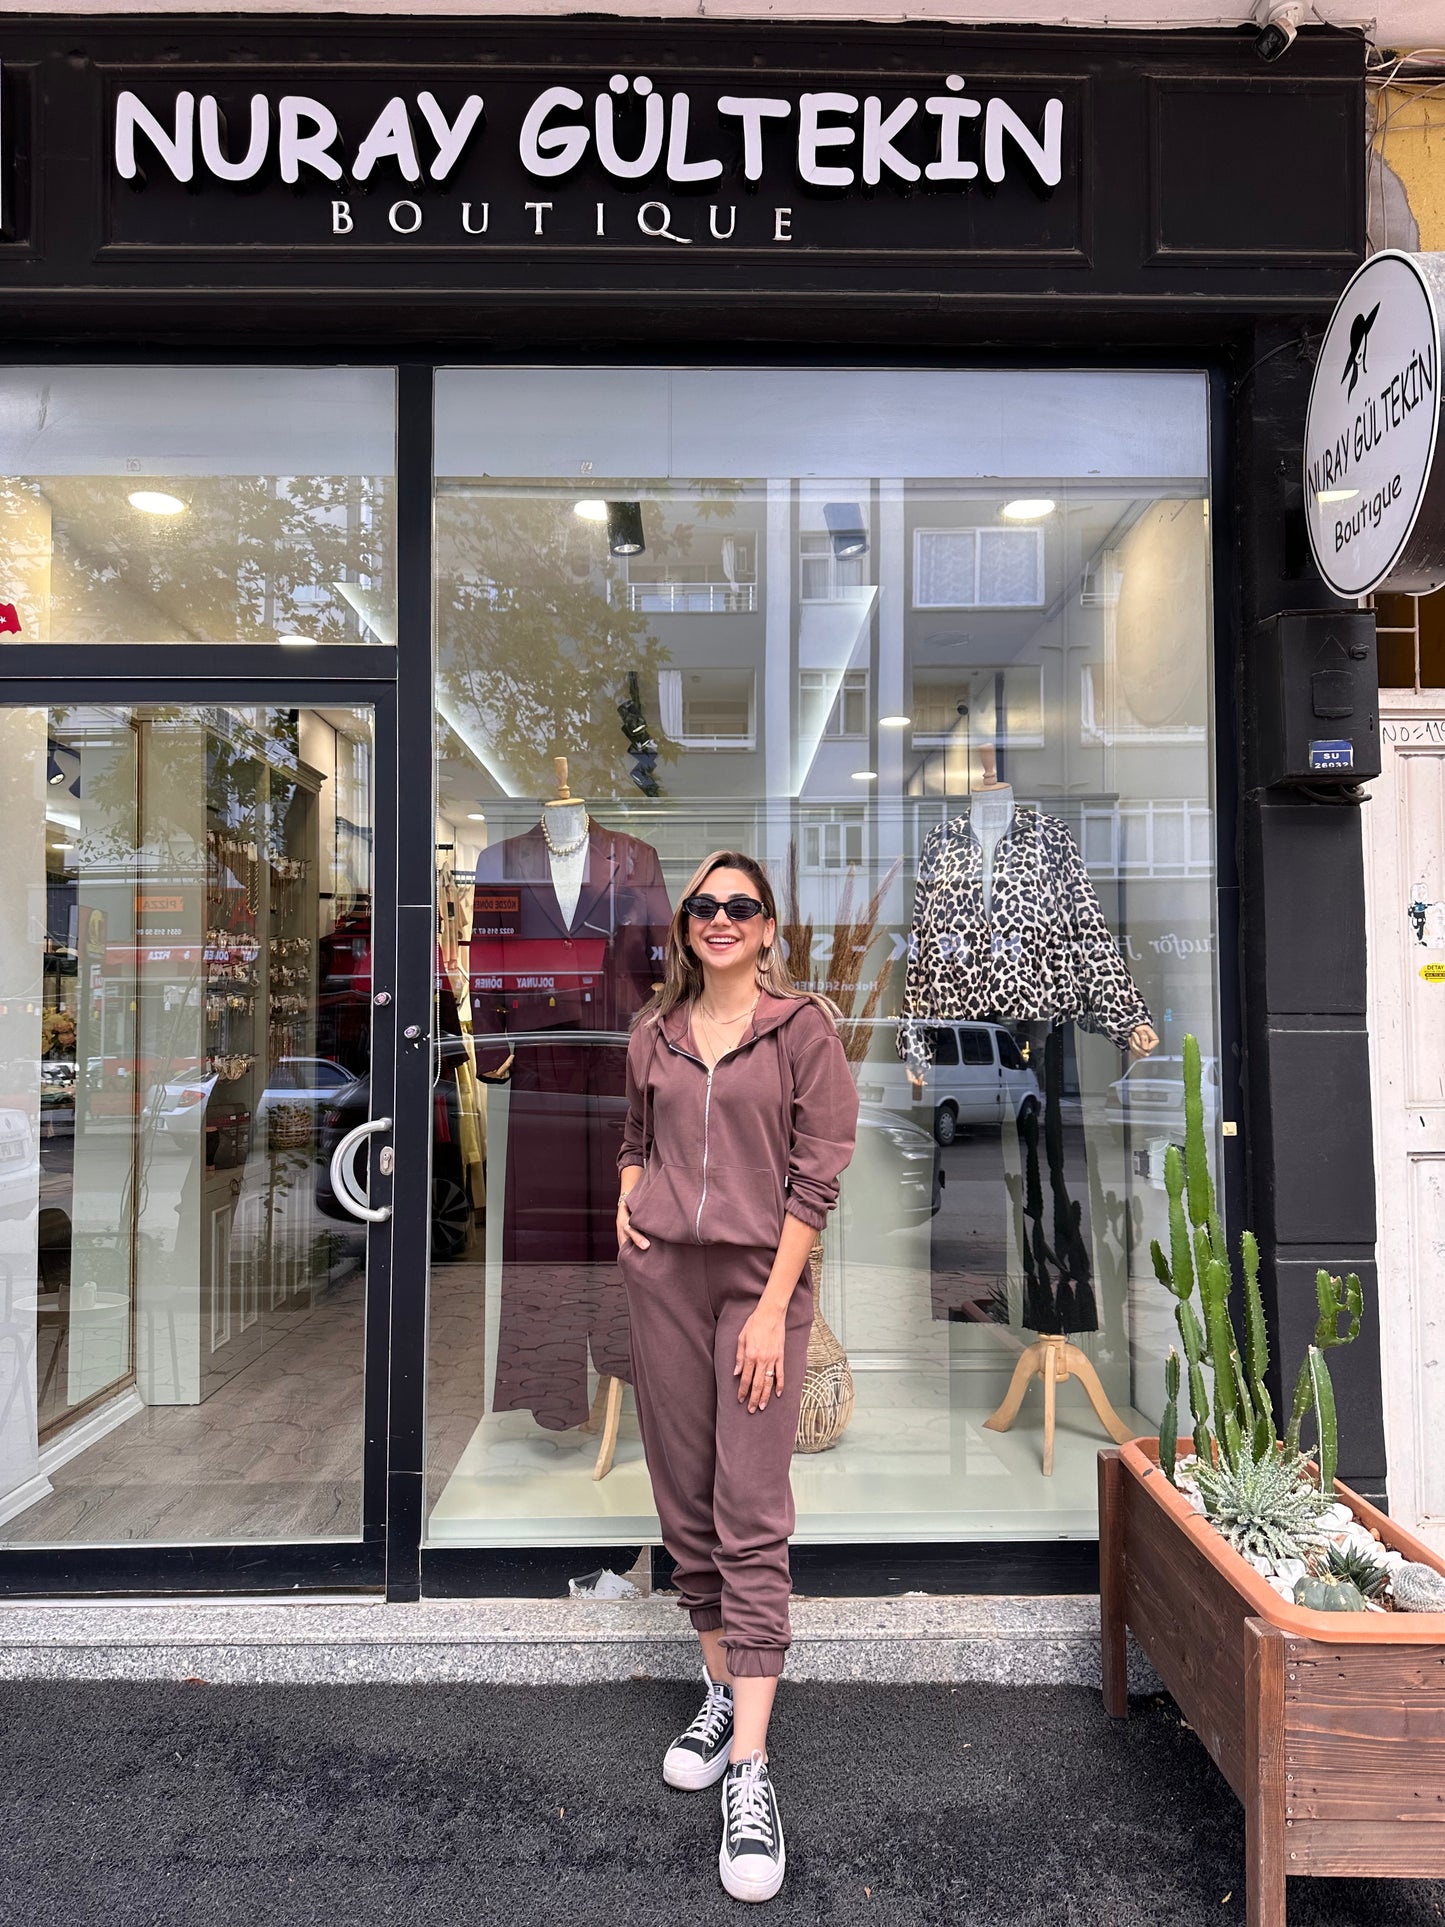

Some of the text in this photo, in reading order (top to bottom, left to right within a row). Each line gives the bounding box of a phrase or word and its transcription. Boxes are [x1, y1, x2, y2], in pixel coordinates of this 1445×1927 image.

[115, 74, 1063, 187] NURAY GÜLTEKİN
[331, 200, 793, 244] BOUTIQUE
[1308, 344, 1433, 509] NURAY GÜLTEKİN
[1323, 752, 1340, 760] SU
